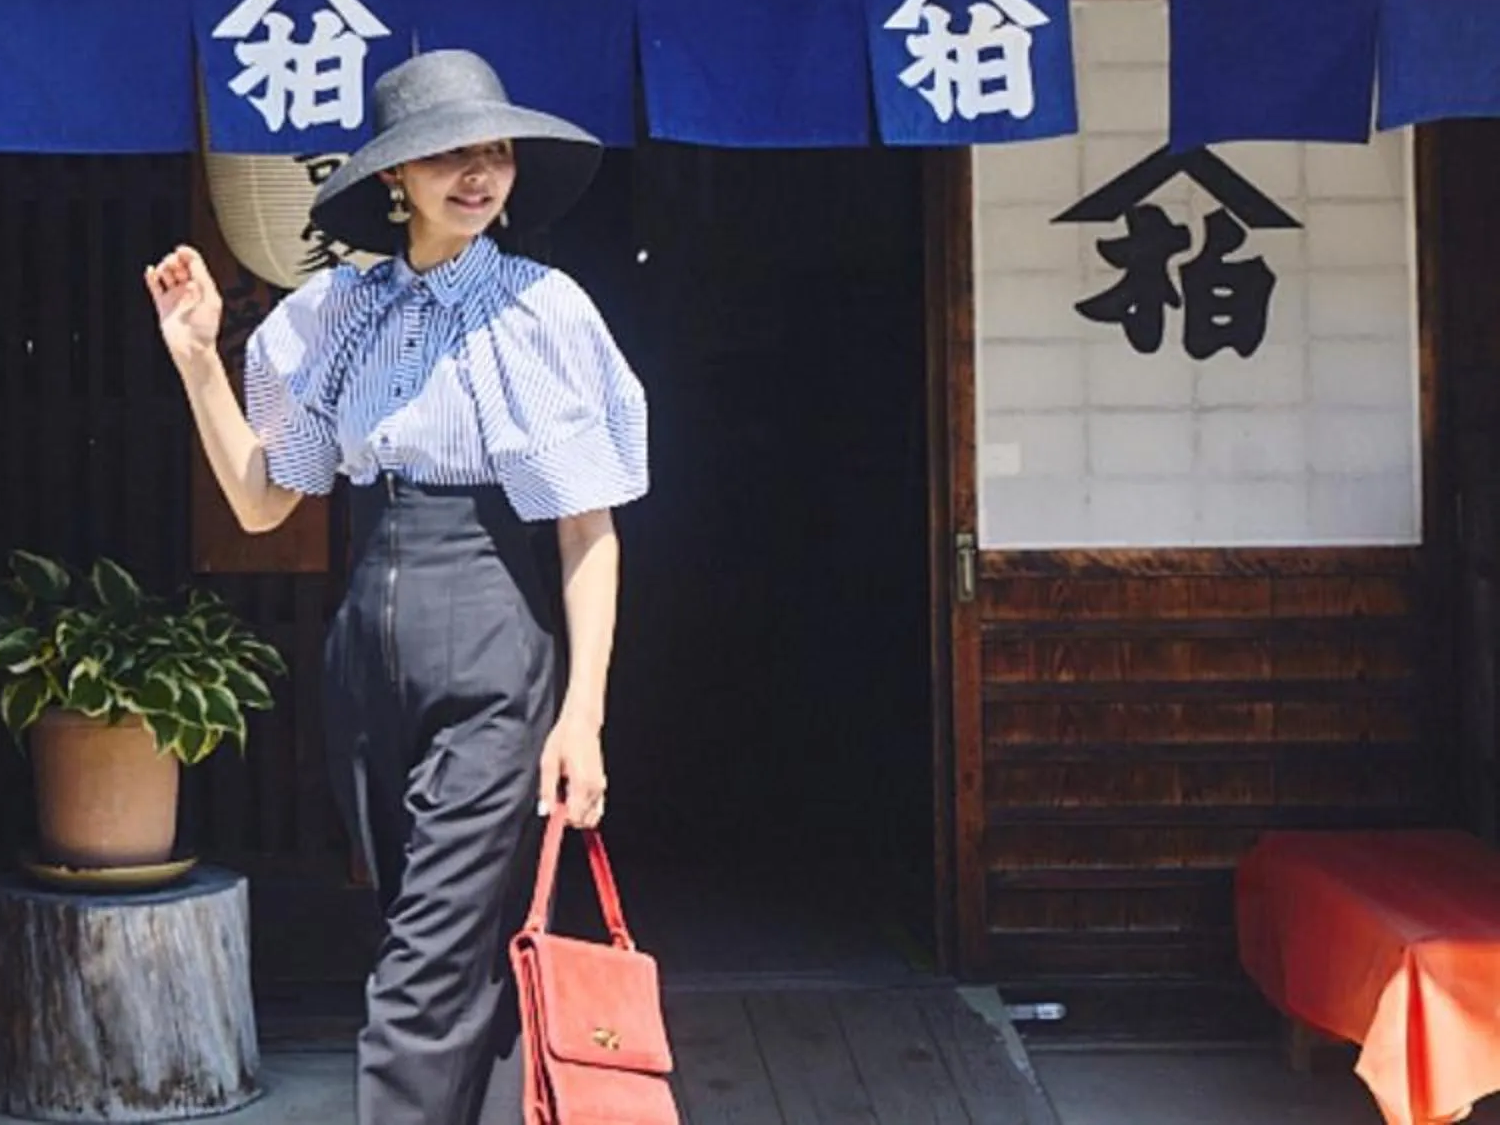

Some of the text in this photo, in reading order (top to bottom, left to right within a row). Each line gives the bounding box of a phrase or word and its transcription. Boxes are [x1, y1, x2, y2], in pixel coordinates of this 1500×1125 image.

[227, 8, 368, 133] 柏
[897, 2, 1034, 123] 柏
[1074, 203, 1277, 361] 柏
